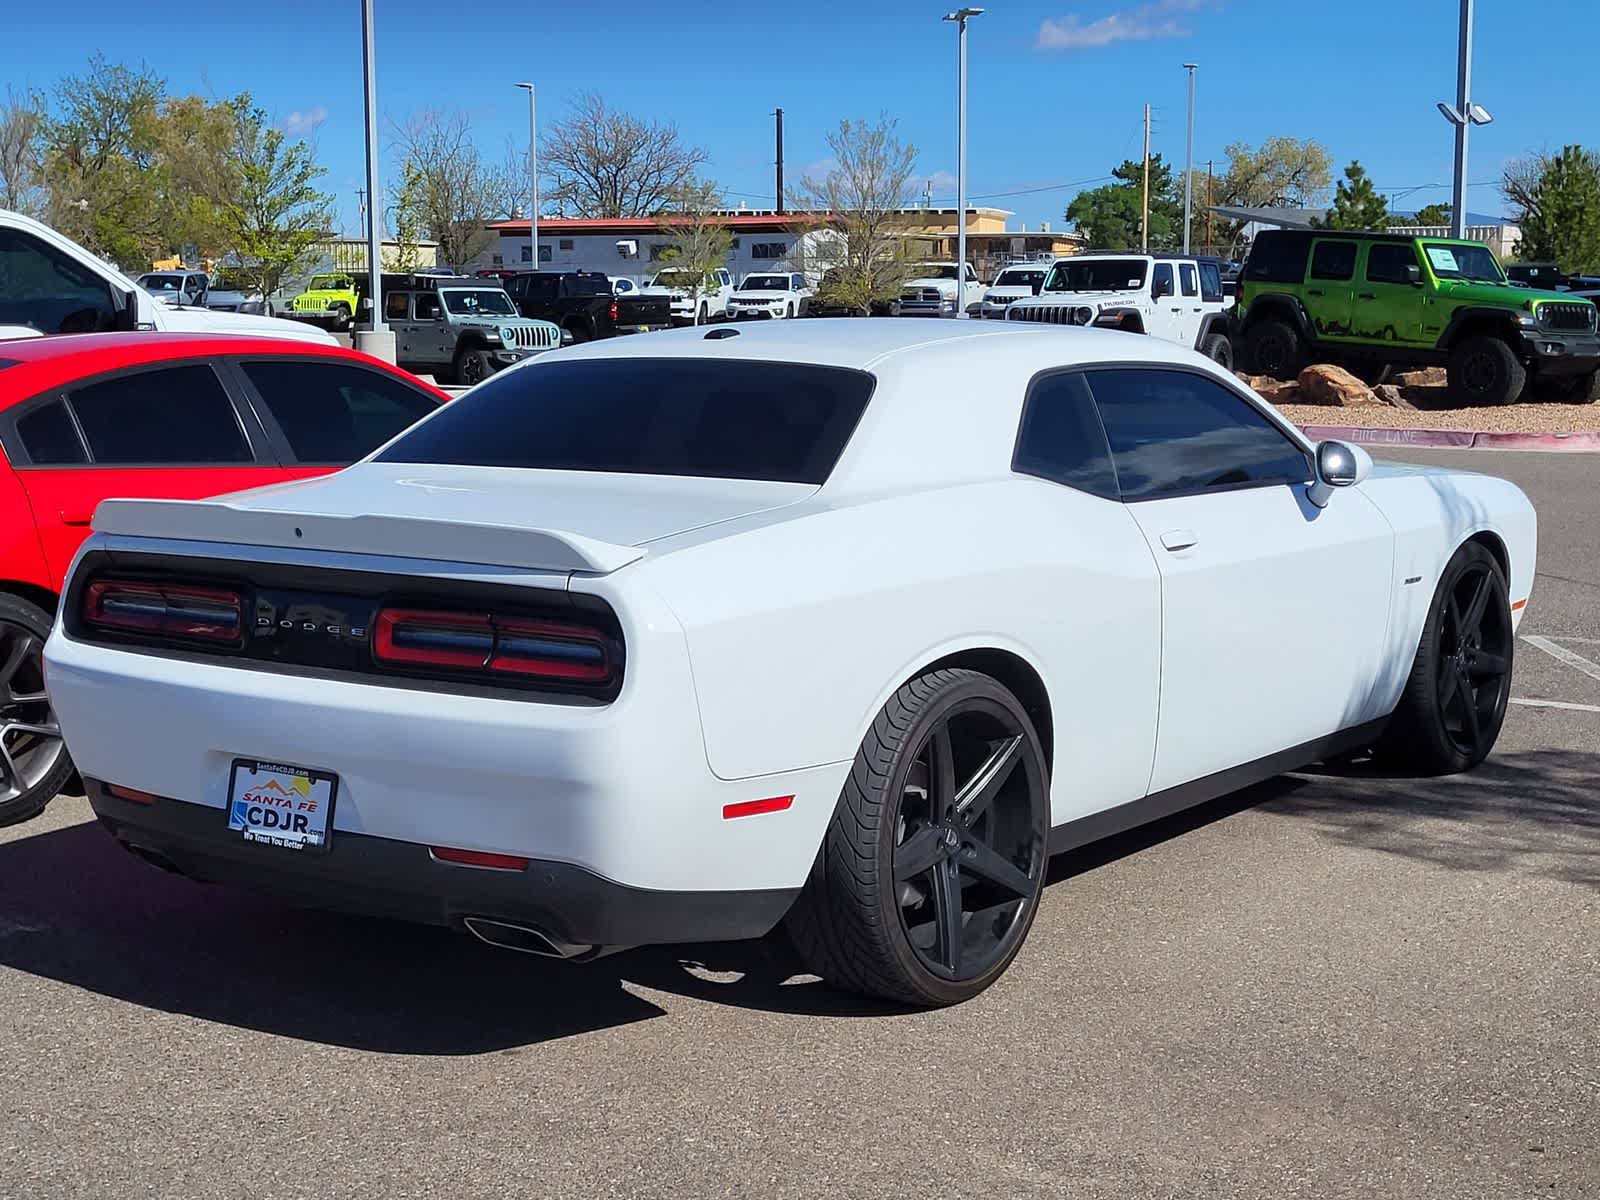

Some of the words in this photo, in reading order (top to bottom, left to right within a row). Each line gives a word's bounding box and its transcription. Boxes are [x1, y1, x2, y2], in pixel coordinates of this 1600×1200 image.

[1351, 429, 1377, 441] FIRE
[1385, 430, 1417, 442] LANE
[257, 617, 365, 636] DODGE
[243, 793, 292, 808] SANTA
[248, 807, 308, 834] CDJR
[244, 832, 253, 841] We
[271, 836, 283, 846] You
[284, 839, 304, 850] Better
